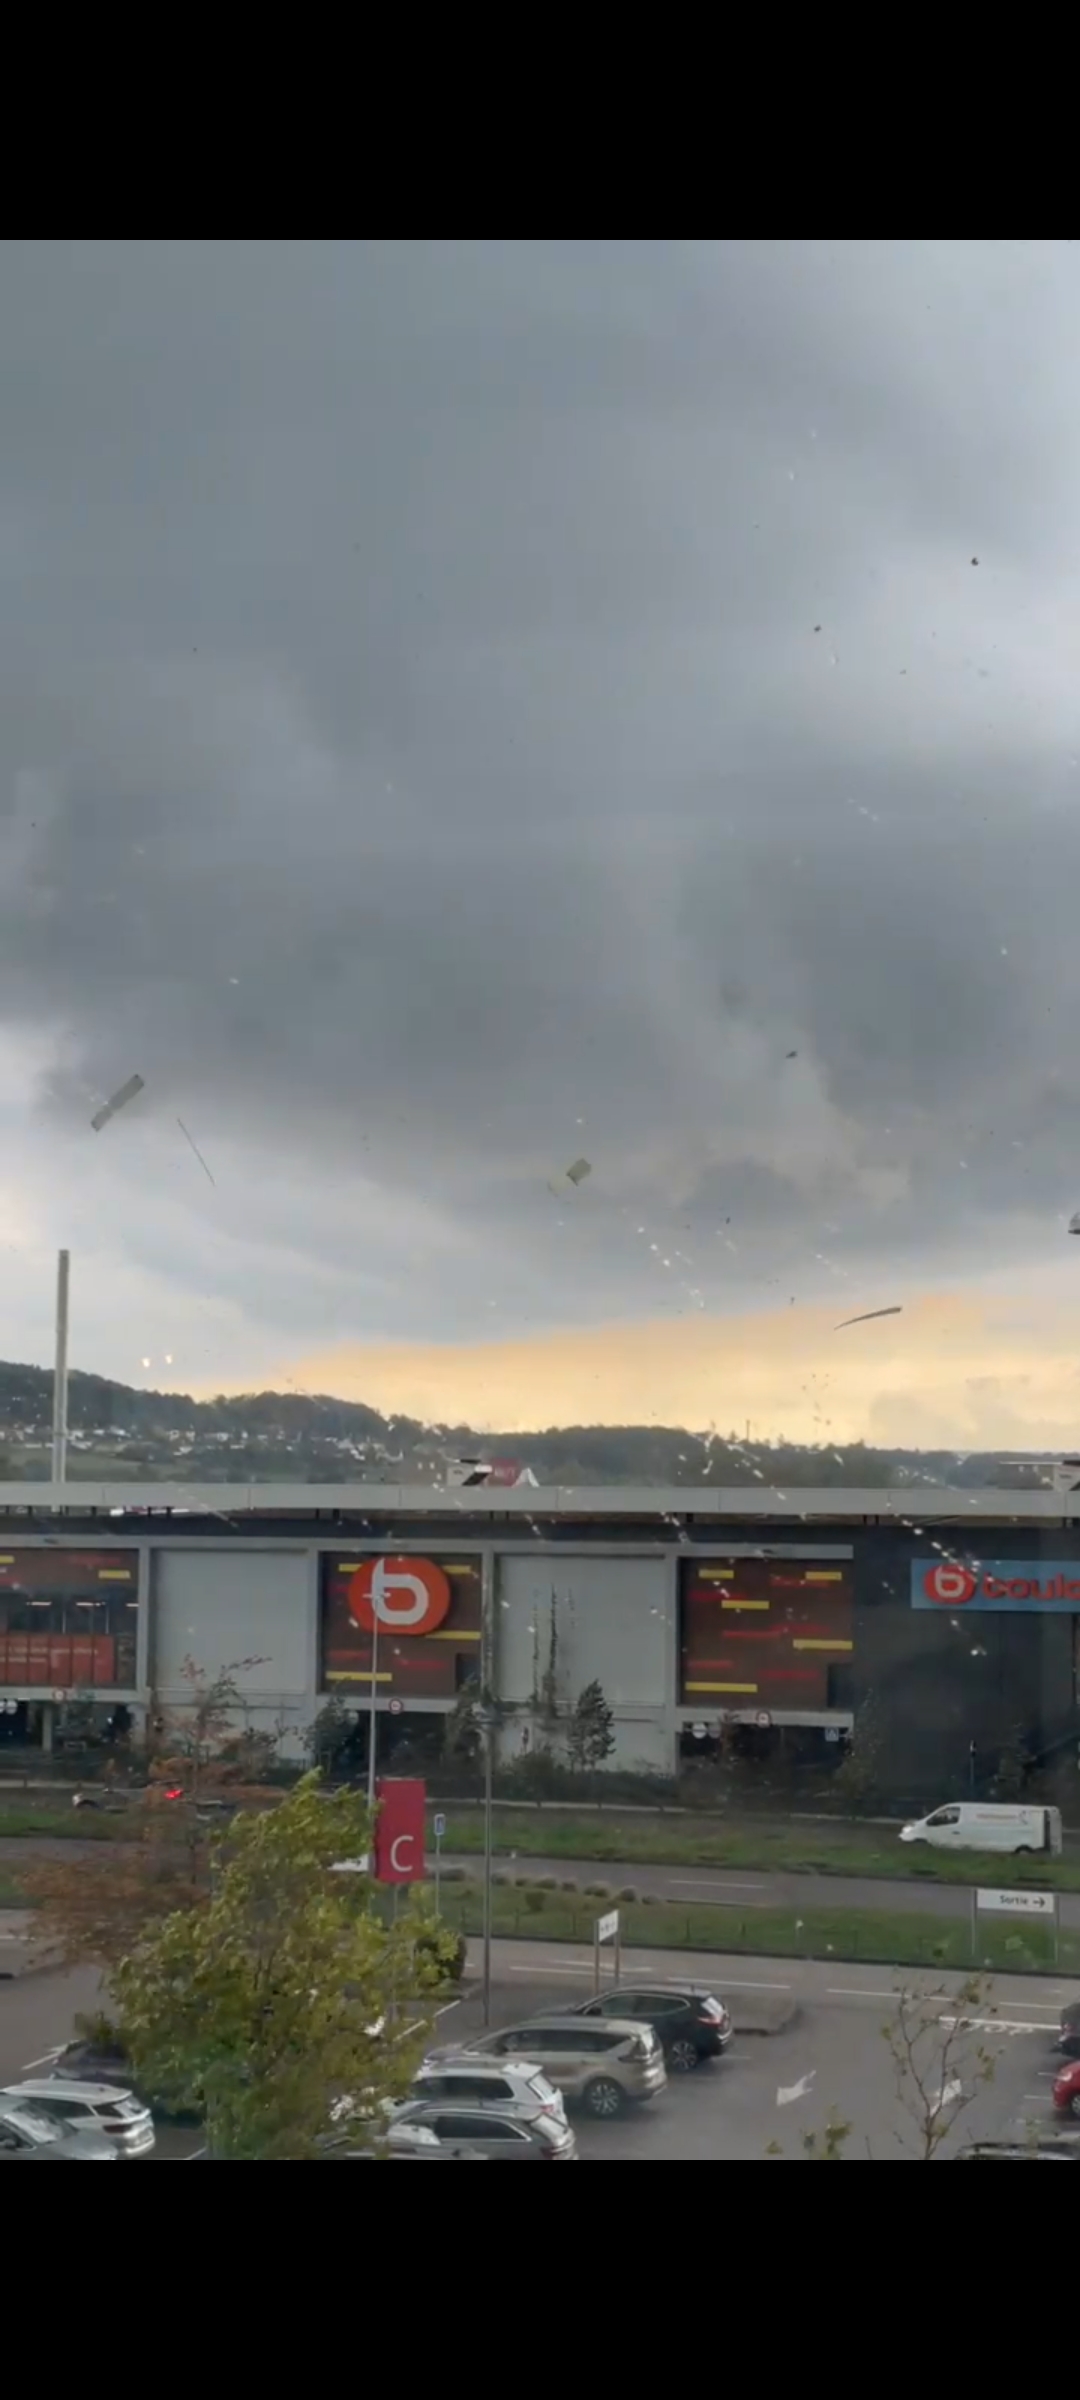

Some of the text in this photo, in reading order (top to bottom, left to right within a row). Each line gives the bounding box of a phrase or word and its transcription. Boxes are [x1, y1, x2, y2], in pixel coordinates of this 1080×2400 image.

[371, 1557, 429, 1627] b
[390, 1835, 414, 1872] C
[999, 1894, 1029, 1905] Sortie
